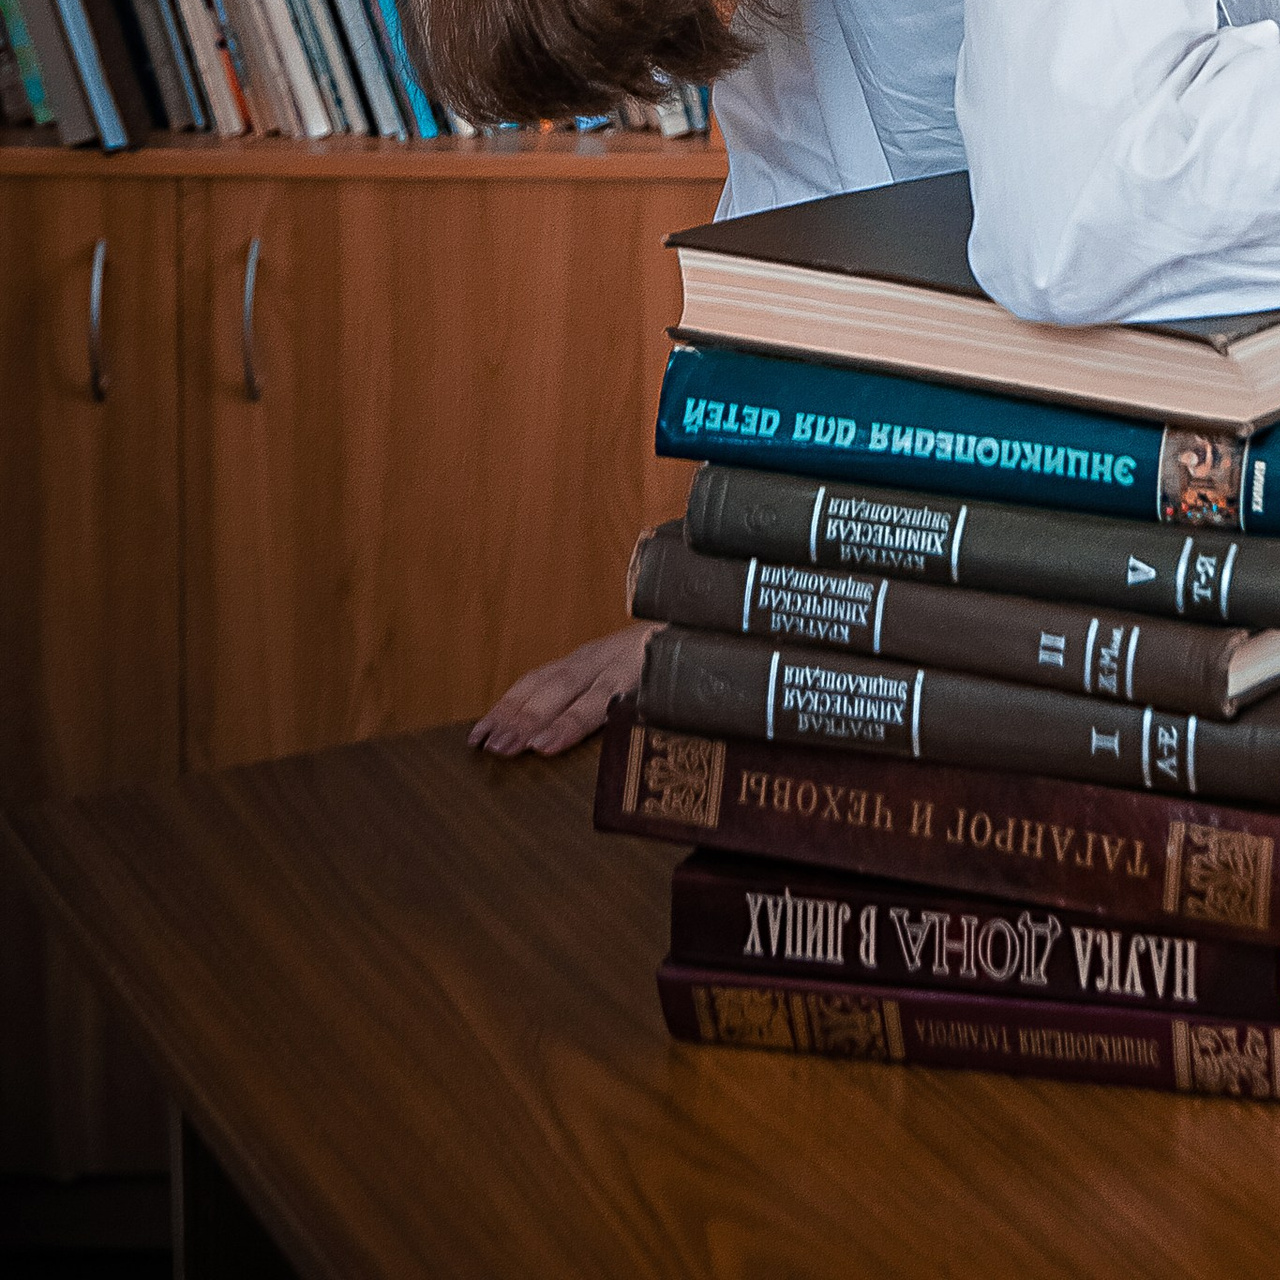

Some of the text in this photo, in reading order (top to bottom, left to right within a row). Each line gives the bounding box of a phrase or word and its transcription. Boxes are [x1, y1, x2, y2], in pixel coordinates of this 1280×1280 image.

[683, 397, 1137, 487] ЭНЦИКЛОПЕДИЯ ДЛЯ ДЕТЕЙ
[827, 496, 950, 532] ЭНЦИКЛОПЕДИЯ
[825, 518, 945, 555] ХИМИЧЕСКАЯ
[839, 544, 924, 571] КРАТКАЯ
[1126, 555, 1156, 585] V
[760, 564, 873, 601] ЭНЦИКЛОПЕДИЯ
[757, 586, 869, 626] ХИМИЧЕСКАЯ
[770, 612, 849, 643] КРАТКАЯ
[783, 665, 907, 700] ЭНЦИКЛОПЕДИЯ
[783, 686, 904, 724] ХИМИЧЕСКАЯ
[797, 711, 885, 740] КРАТКАЯ
[737, 768, 1149, 878] ТАГАНРОГ И ЧЕХОВЫ
[741, 886, 1197, 1002] НАУКА ДОНА В ЛИЦАХ
[912, 1017, 1160, 1068] ЭНЦИКЛОПЕДИЯ ТАГАНРОГА
